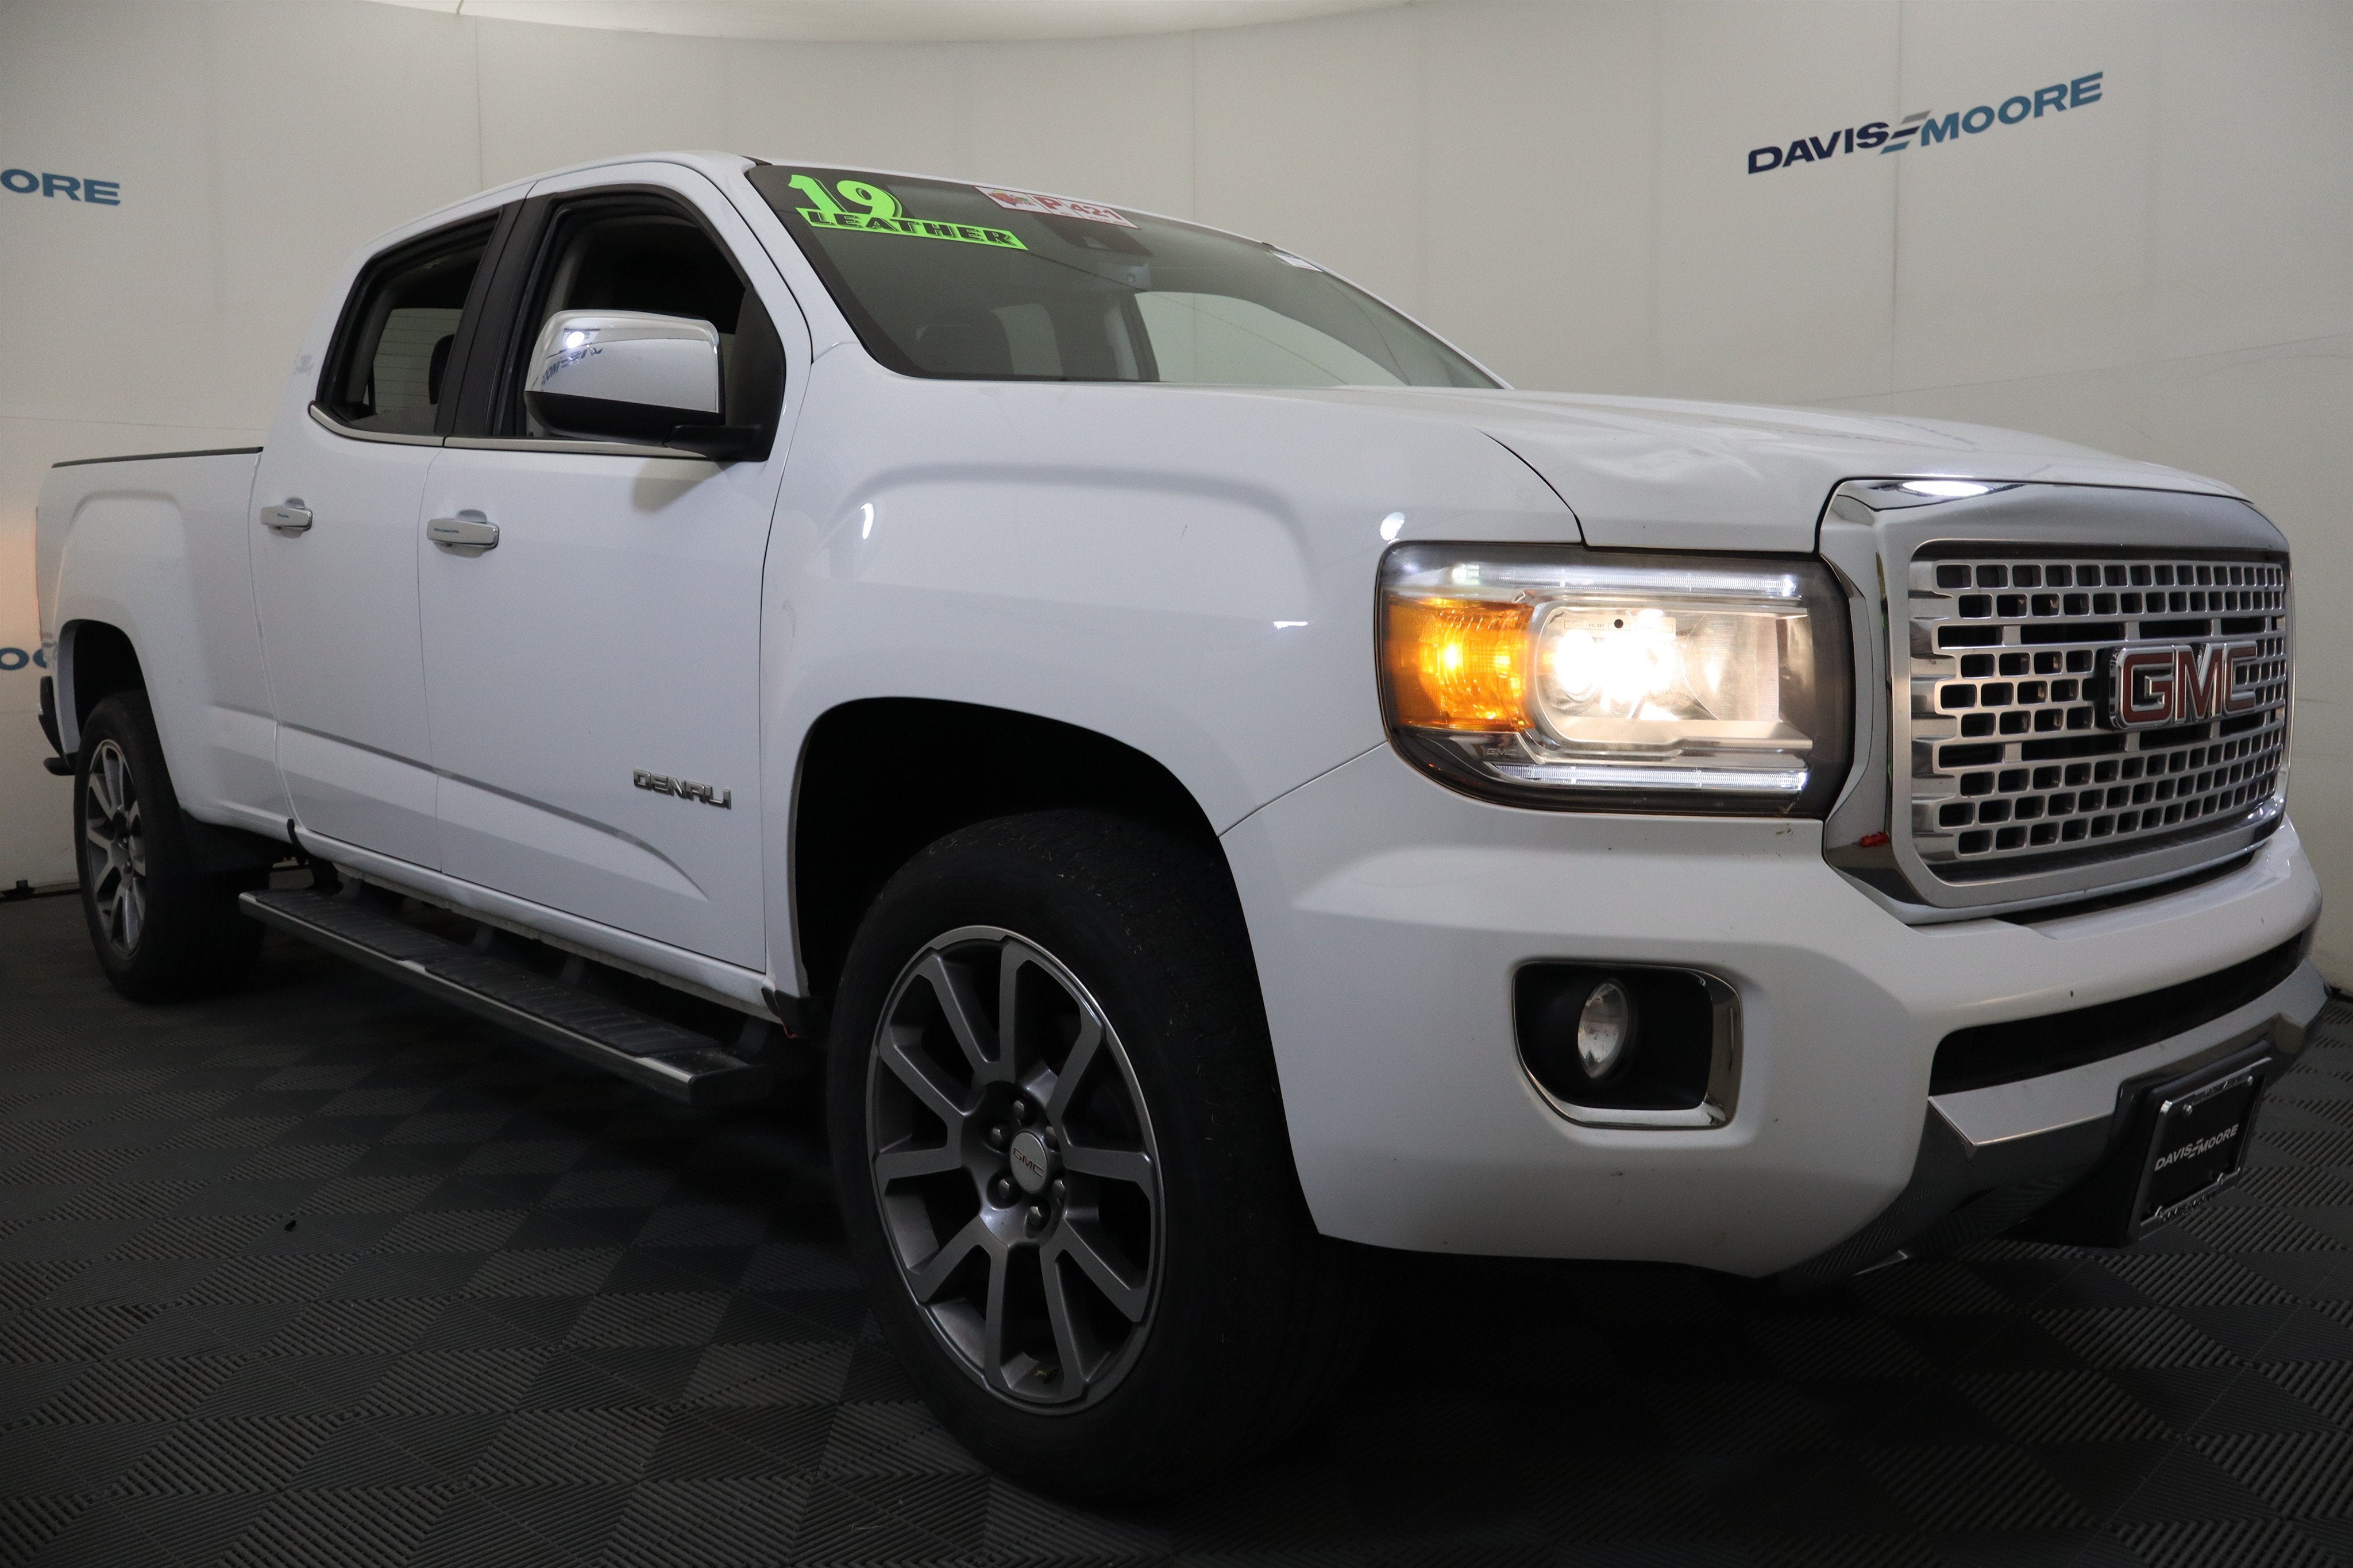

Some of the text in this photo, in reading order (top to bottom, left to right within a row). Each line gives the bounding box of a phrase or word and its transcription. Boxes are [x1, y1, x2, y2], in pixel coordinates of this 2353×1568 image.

[0, 169, 121, 206] ORE
[788, 174, 902, 218] 19
[1032, 196, 1062, 210] P
[1070, 203, 1124, 221] 421
[807, 210, 1016, 245] LEATHER
[2112, 640, 2258, 729] GMC
[1486, 747, 1517, 756] GMC
[633, 768, 731, 810] DENALI
[1013, 1147, 1044, 1178] GMC
